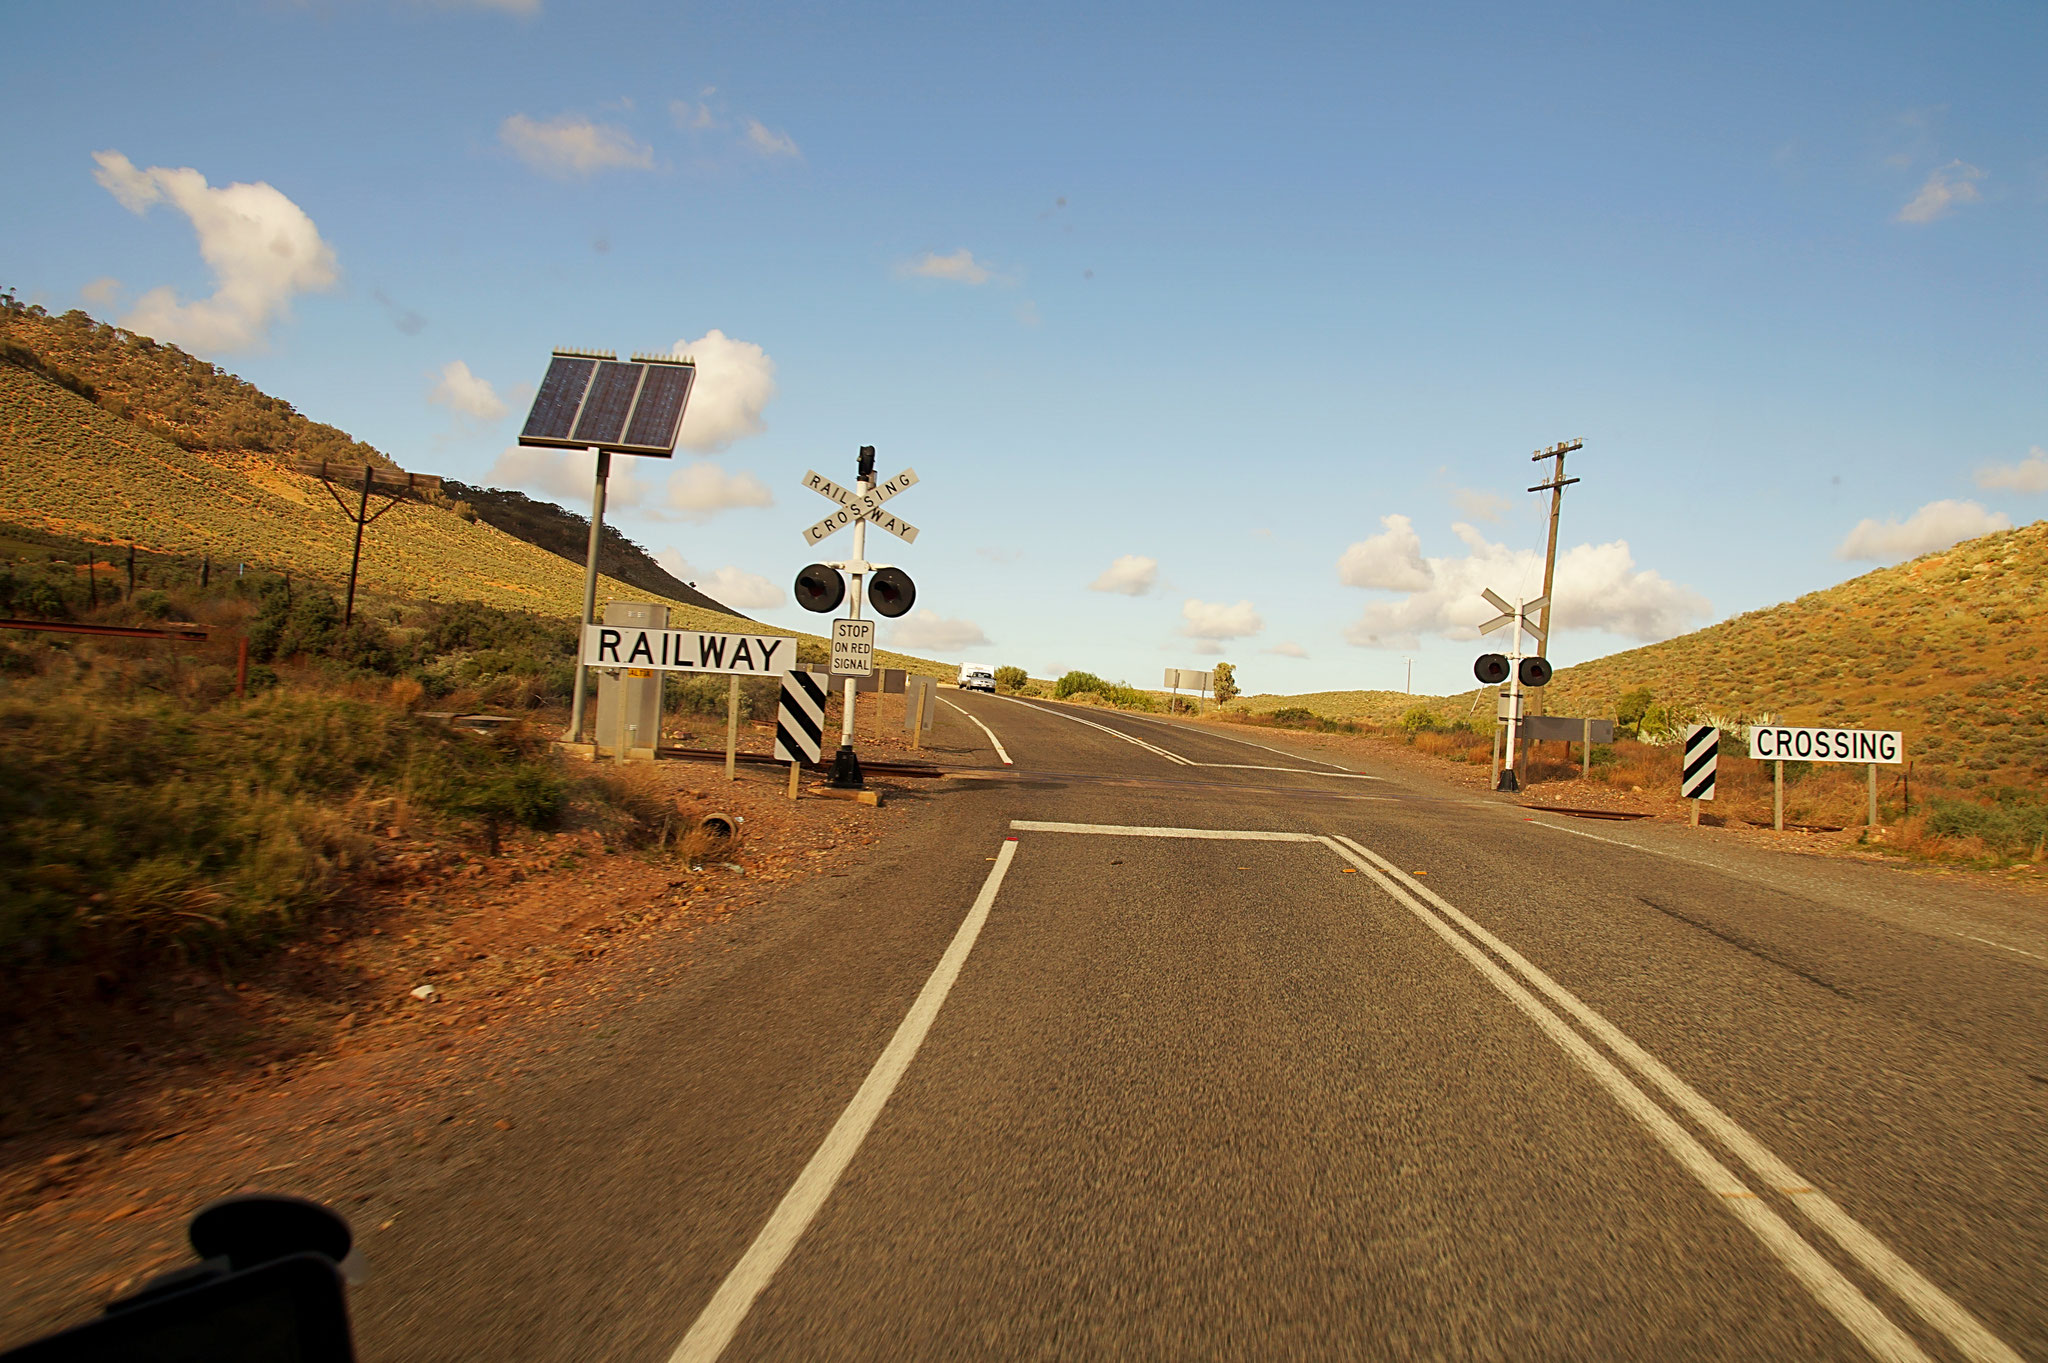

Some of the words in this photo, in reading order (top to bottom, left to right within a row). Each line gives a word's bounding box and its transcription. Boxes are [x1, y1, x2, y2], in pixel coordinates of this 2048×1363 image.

[812, 474, 910, 539] CROSSING
[839, 624, 869, 637] STOP
[598, 629, 782, 671] RAILWAY
[834, 642, 849, 653] ON
[851, 643, 870, 654] RED
[834, 658, 870, 671] SIGNAL
[1757, 729, 1895, 760] CROSSING
